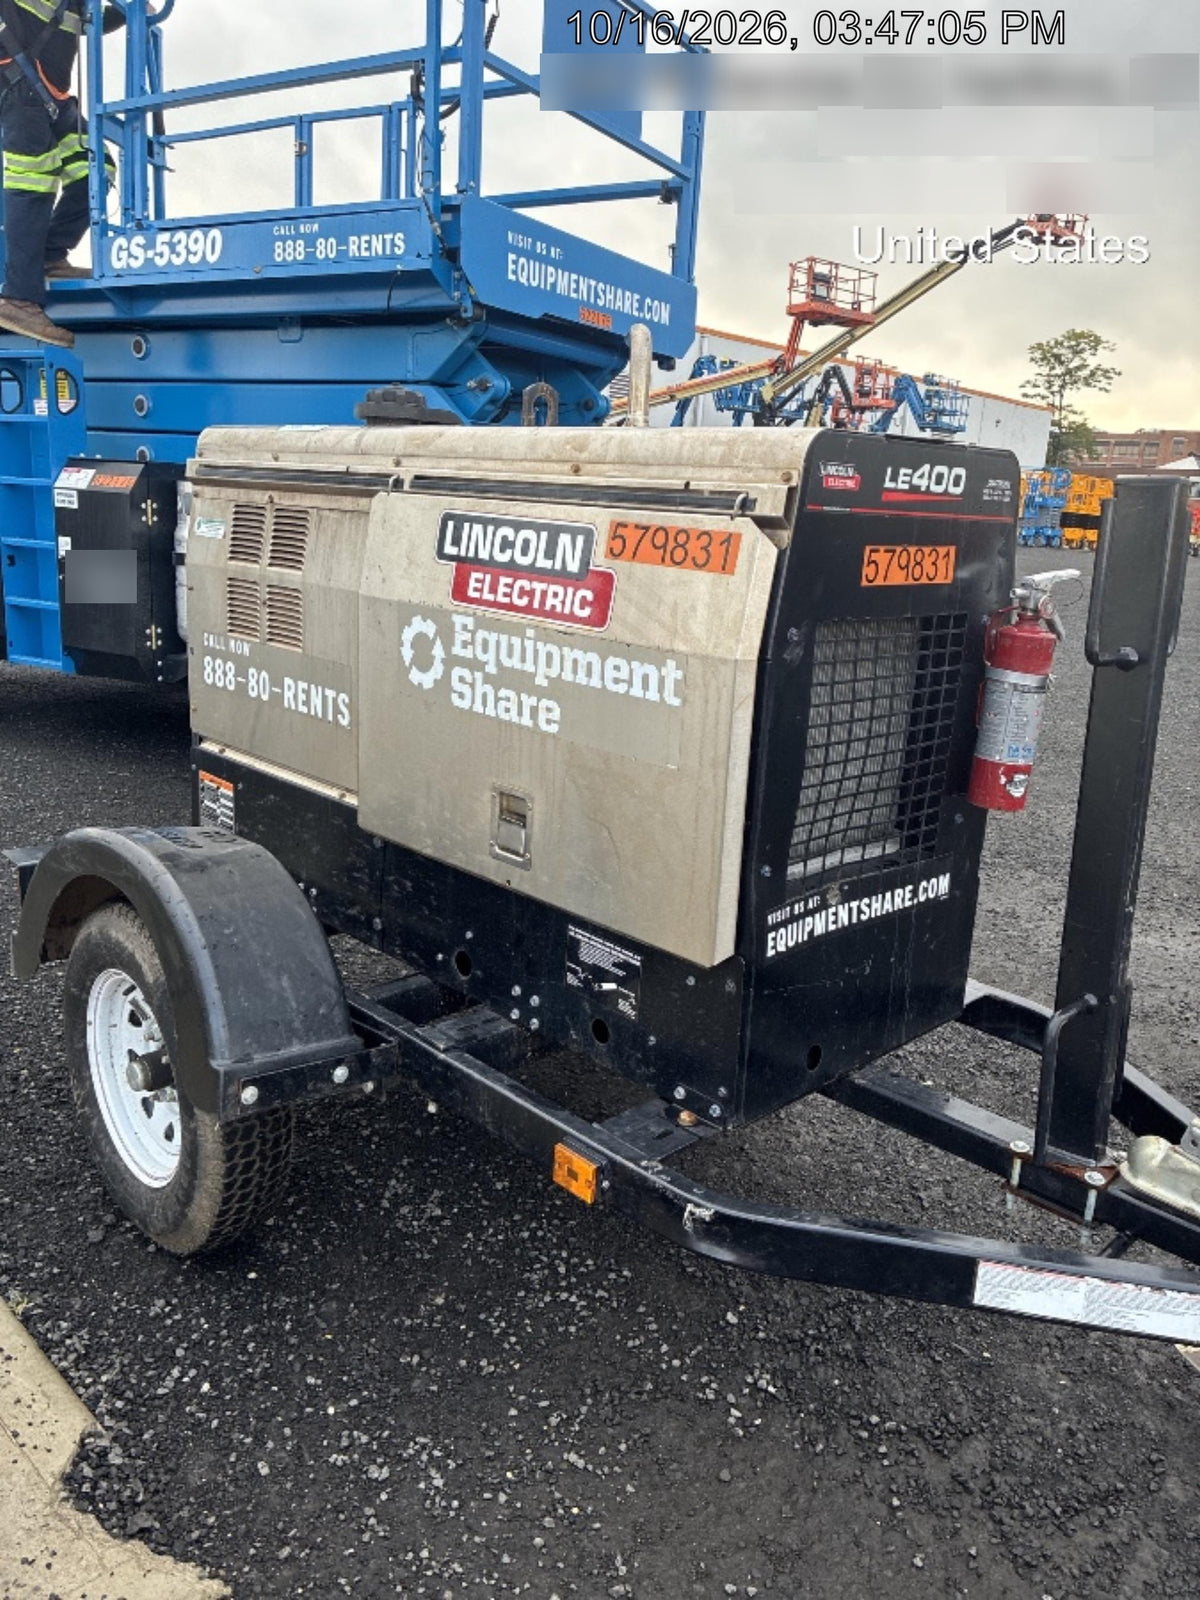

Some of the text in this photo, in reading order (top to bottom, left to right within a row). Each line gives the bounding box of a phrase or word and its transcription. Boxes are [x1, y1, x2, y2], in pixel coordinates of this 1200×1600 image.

[110, 227, 223, 270] GS-5390
[273, 223, 319, 236] CALL NOW
[274, 232, 406, 263] 888-80-RENTS
[507, 230, 533, 251] VISIT
[536, 240, 547, 256] US
[507, 252, 672, 326] EQUIPMENTSHARE.COM
[883, 463, 967, 495] LE400
[443, 520, 584, 573] LINCOLN
[608, 522, 733, 572] 579831
[864, 546, 951, 584] 579831
[467, 571, 594, 619] ELECTRIC
[204, 632, 250, 657] CALL NOW
[450, 613, 684, 708] Equipment
[203, 655, 351, 728] 888-80-RENTS
[450, 666, 561, 734] Share
[766, 872, 951, 957] EQUIPMENTSHARE.COM
[767, 895, 821, 926] VISIT US AT:
